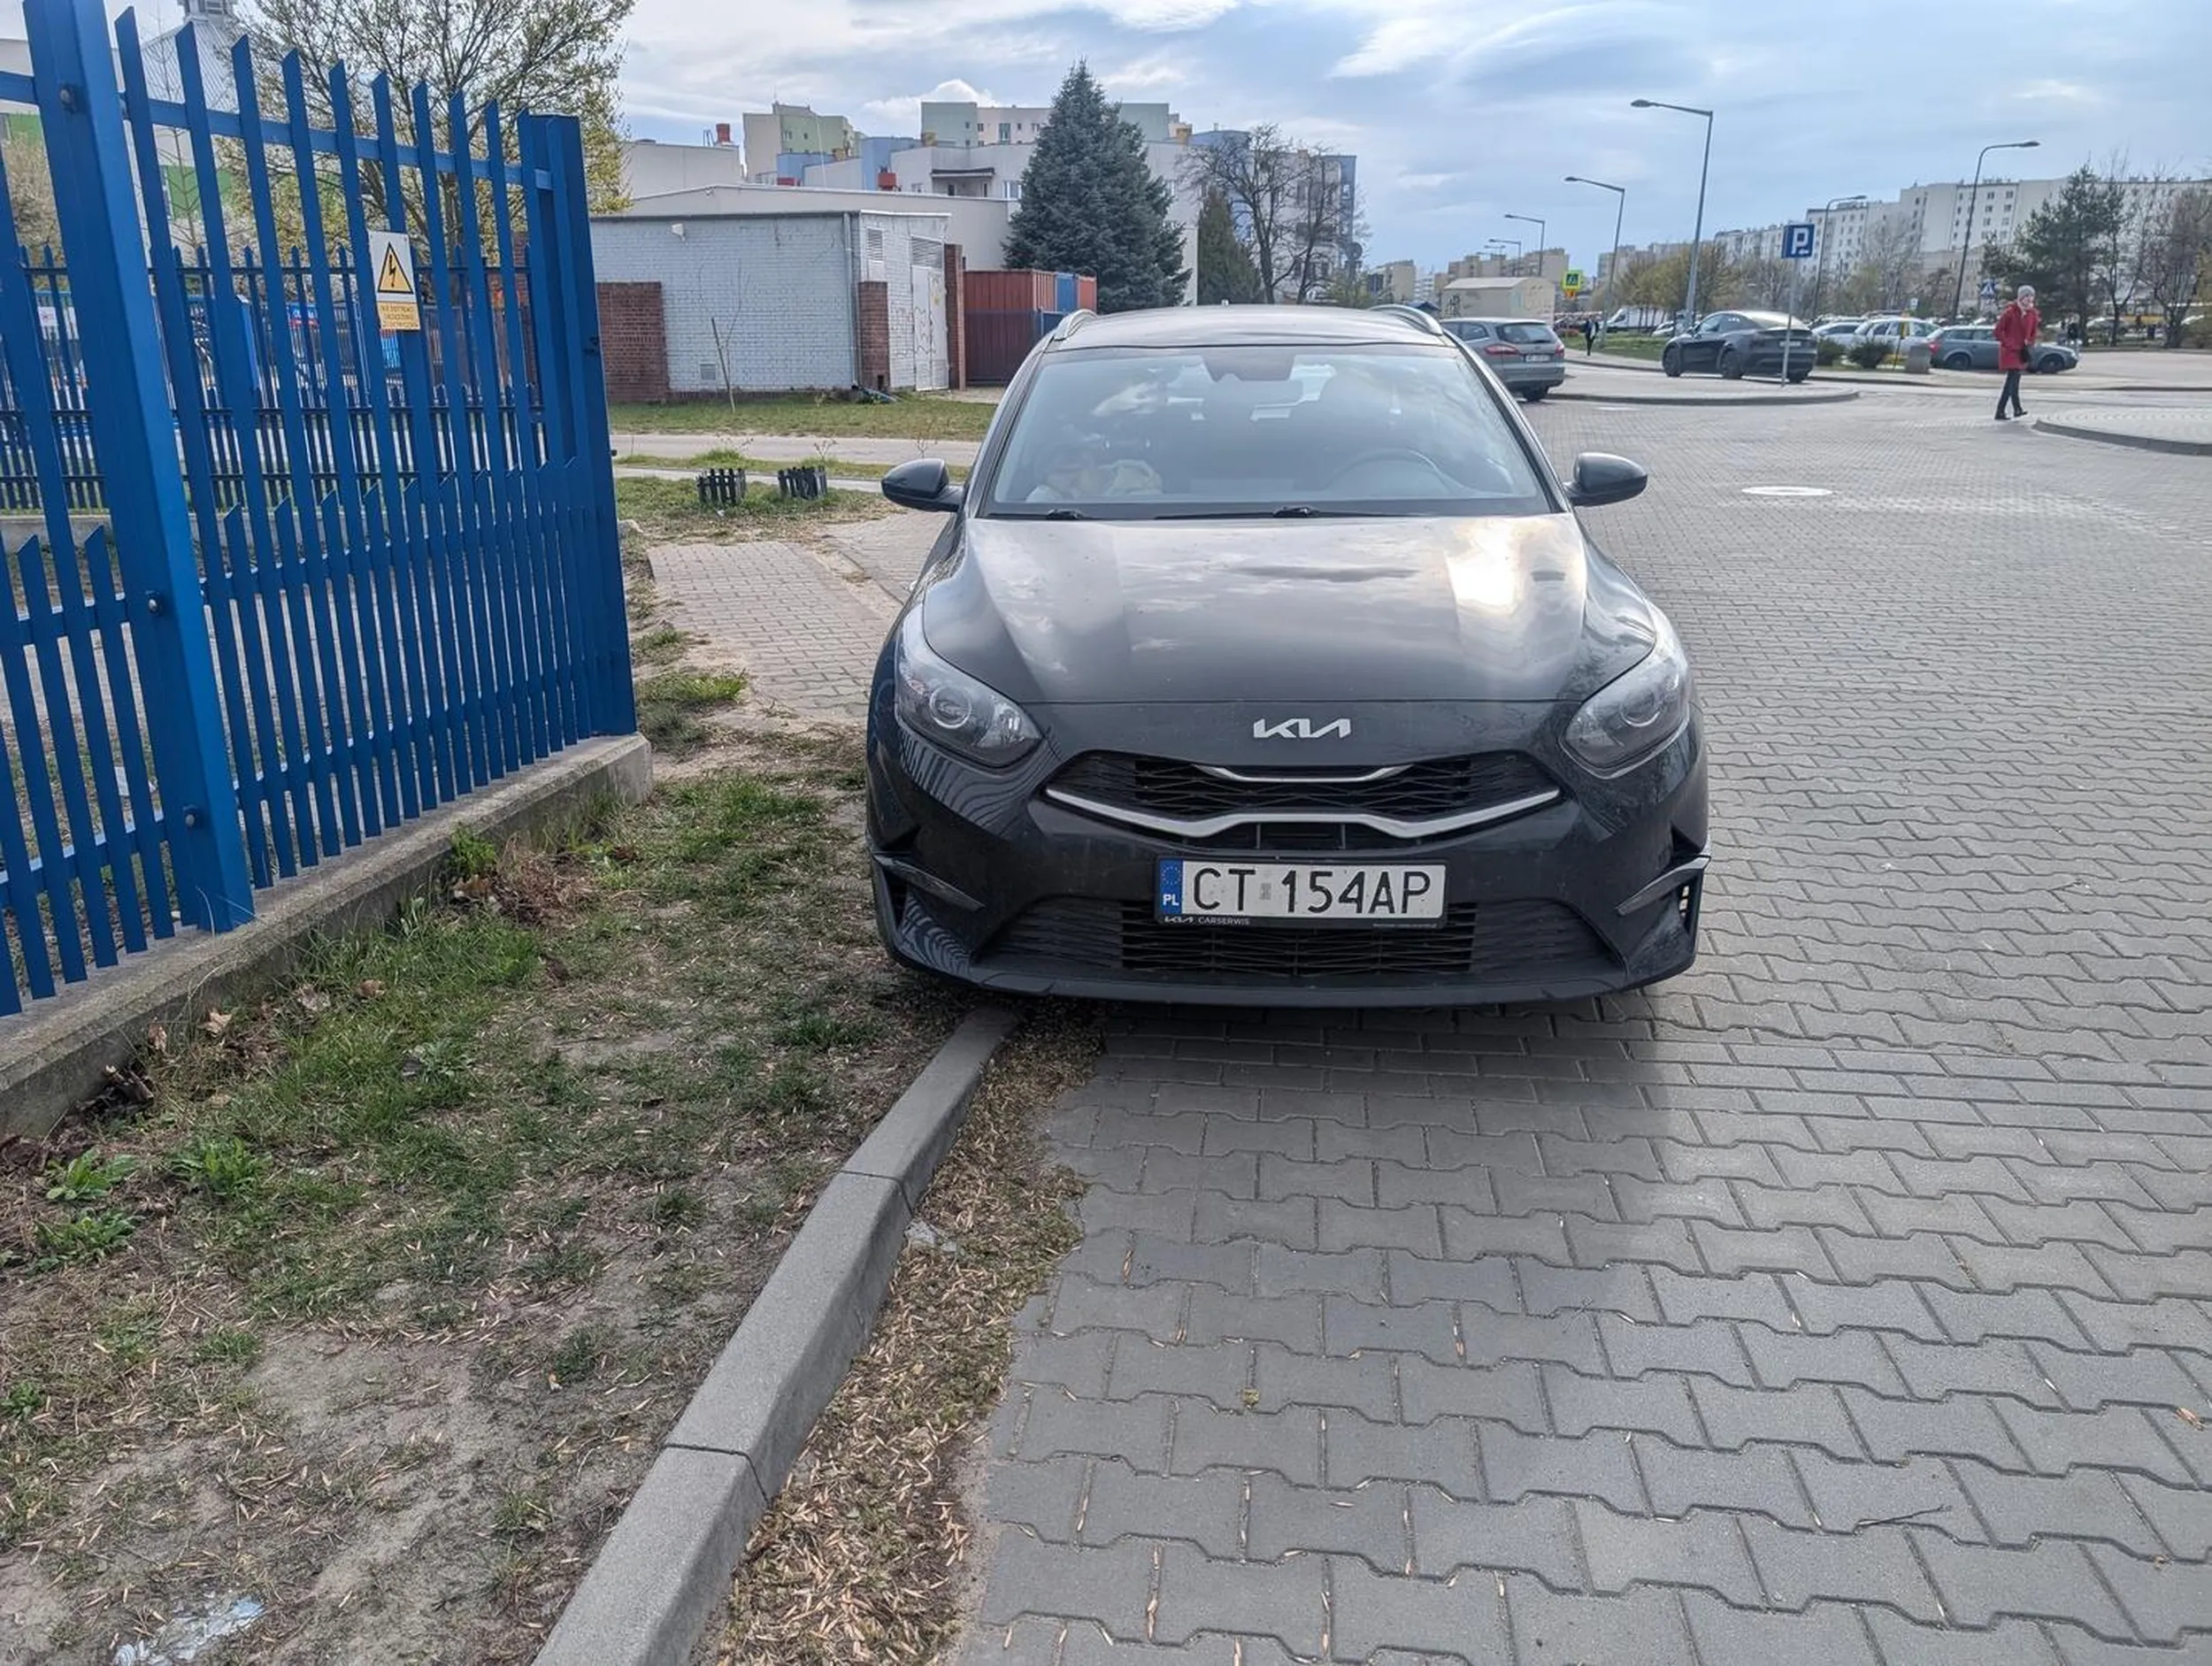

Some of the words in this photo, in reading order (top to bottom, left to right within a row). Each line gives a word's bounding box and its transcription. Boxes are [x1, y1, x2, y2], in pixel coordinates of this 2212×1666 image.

[1791, 227, 1809, 255] P
[1253, 718, 1352, 739] KIA
[1162, 894, 1179, 907] PL
[1194, 868, 1256, 911] CT
[1281, 870, 1432, 914] 154AP
